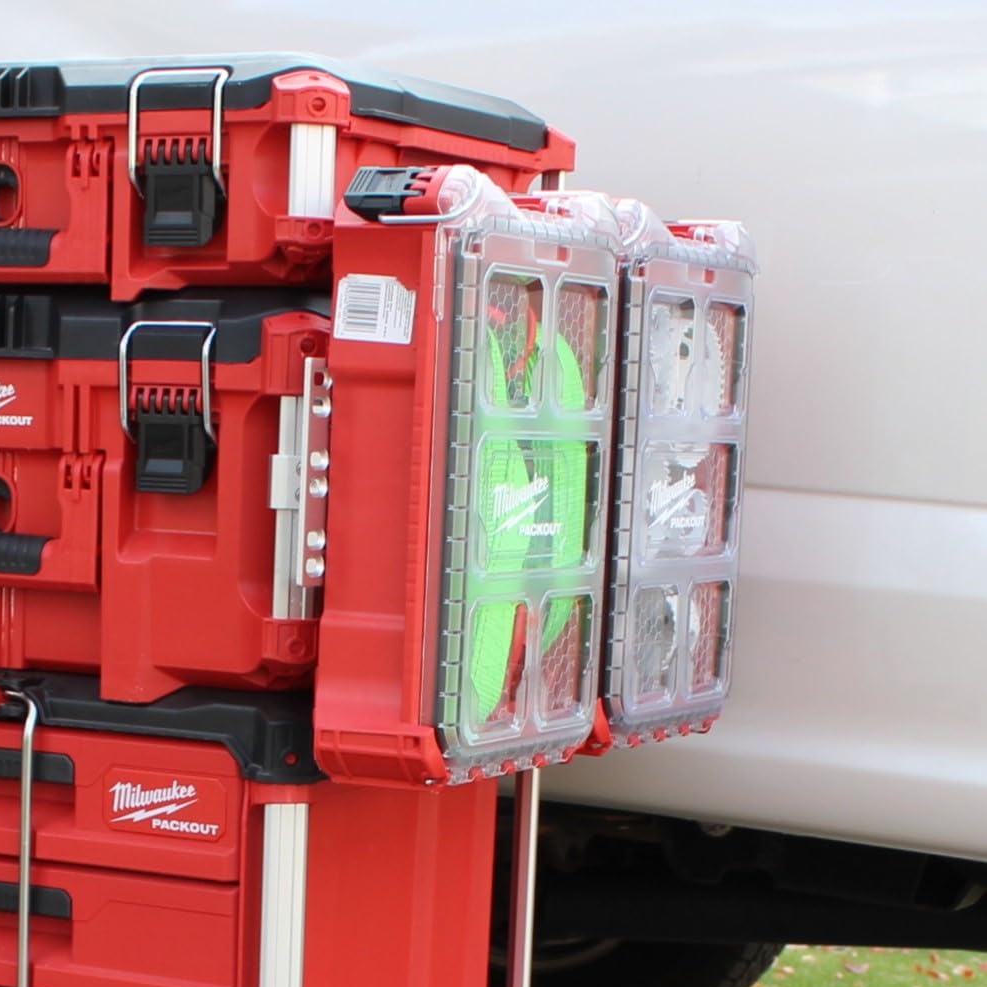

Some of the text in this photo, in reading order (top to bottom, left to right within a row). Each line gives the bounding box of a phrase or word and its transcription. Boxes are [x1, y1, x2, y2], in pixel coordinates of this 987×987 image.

[492, 472, 549, 523] Milwaukee
[648, 470, 696, 517] Milwaukee
[518, 522, 562, 536] PACKOUT
[670, 515, 706, 528] PACKOUT
[109, 780, 197, 812] Milwaukee
[152, 818, 219, 836] PACKOUT
